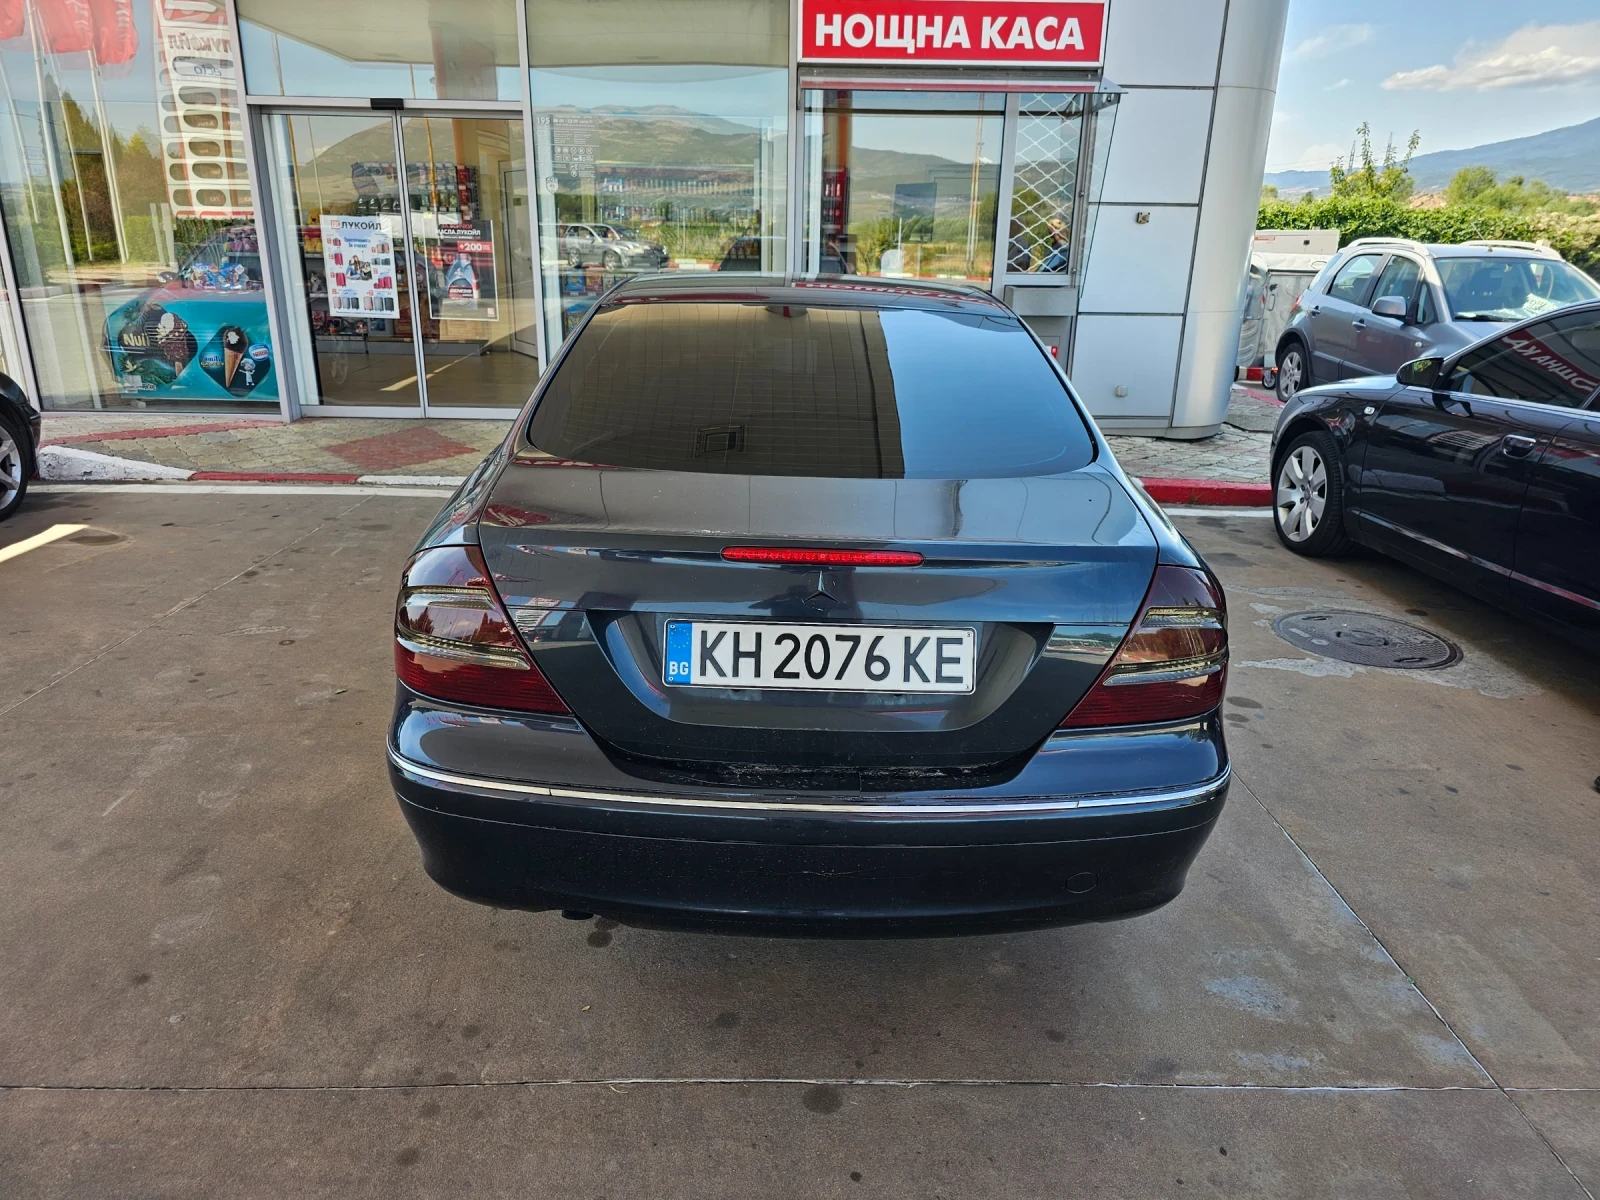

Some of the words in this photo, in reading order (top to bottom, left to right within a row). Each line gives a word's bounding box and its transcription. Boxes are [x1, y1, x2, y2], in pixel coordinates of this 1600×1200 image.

[816, 13, 971, 54] НОЩНА
[981, 16, 1084, 51] КАСА
[341, 220, 382, 230] ЛУКОЙЛ
[459, 243, 482, 252] +200
[699, 630, 763, 678] KH
[773, 633, 891, 682] 2076
[903, 636, 964, 684] KE
[669, 661, 689, 676] BG
